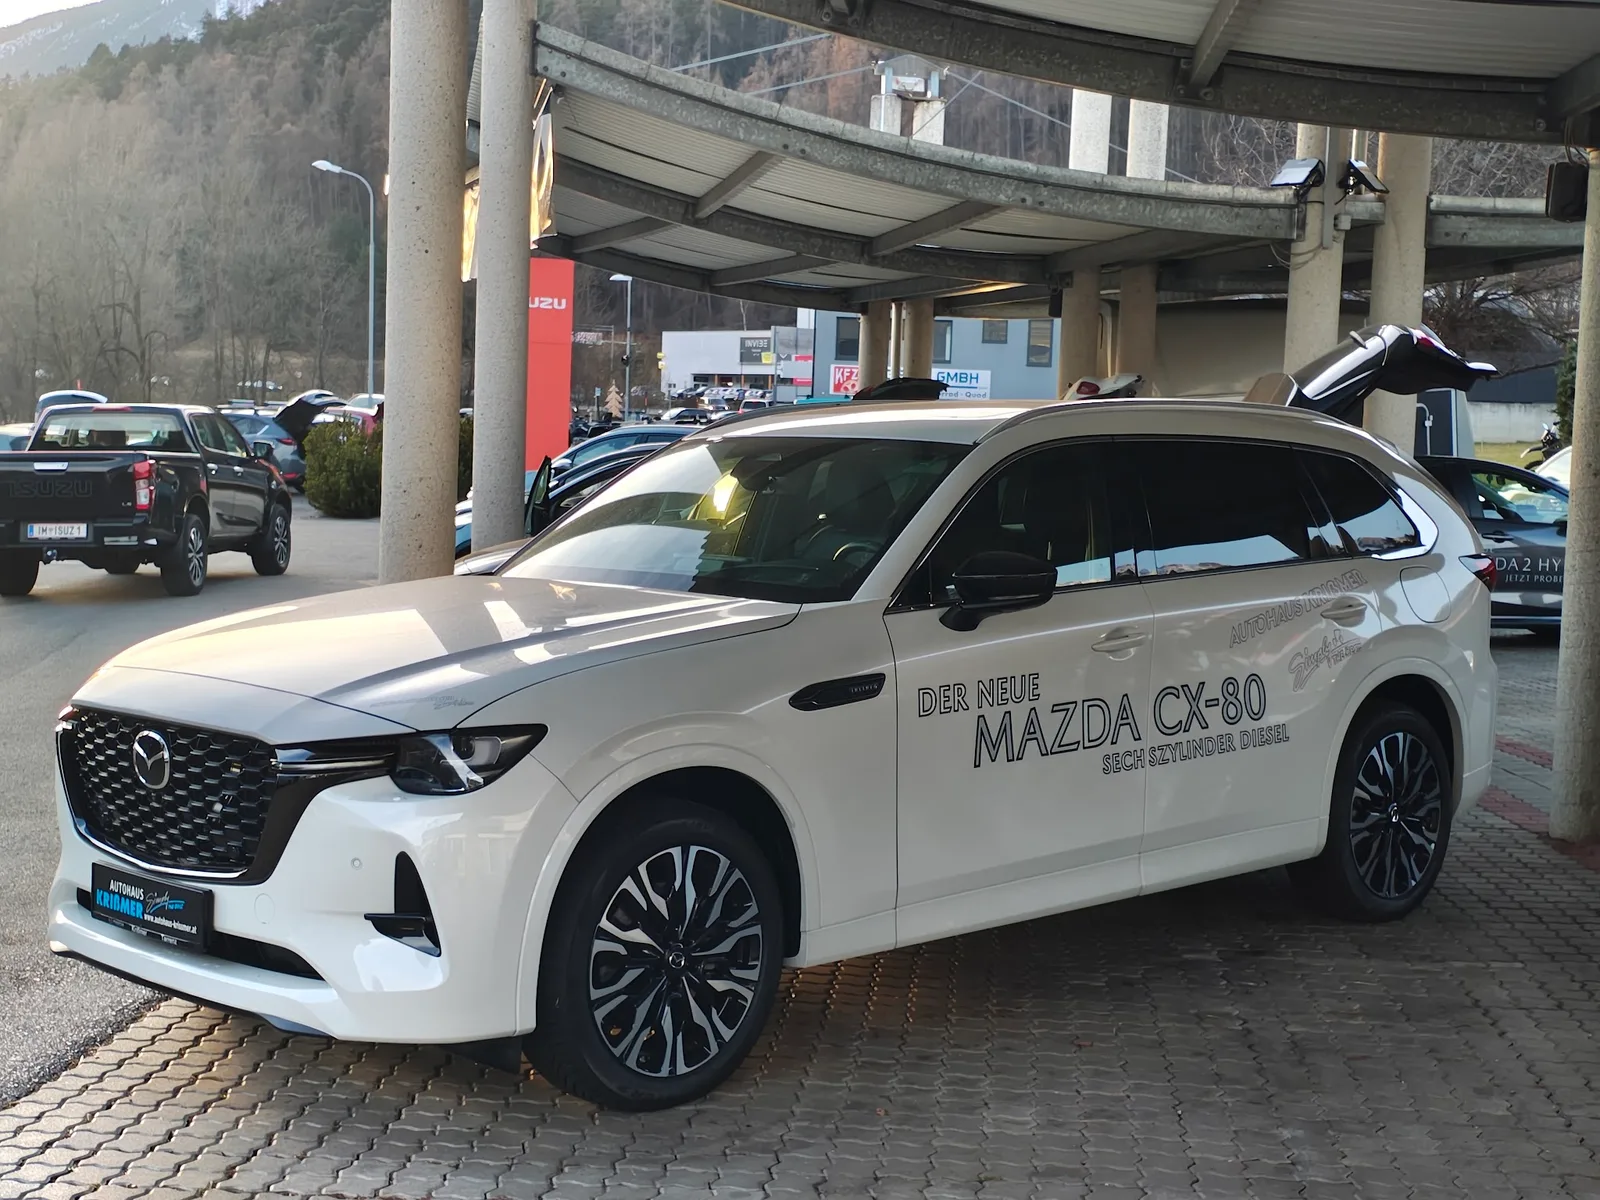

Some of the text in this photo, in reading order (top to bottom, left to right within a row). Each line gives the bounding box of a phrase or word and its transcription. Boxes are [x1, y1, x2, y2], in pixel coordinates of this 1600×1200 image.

[528, 296, 567, 310] UZU
[936, 371, 979, 384] GMBH
[8, 480, 93, 498] ISUZU
[1495, 557, 1562, 572] DA 2 HY
[1505, 574, 1531, 583] JETZT
[1229, 597, 1305, 648] AUTOHAUS
[918, 672, 1041, 718] DER NEUE
[973, 673, 1267, 769] MAZDA CX-80
[1239, 723, 1290, 750] DIESEL
[109, 879, 145, 900] AUTOHAUS
